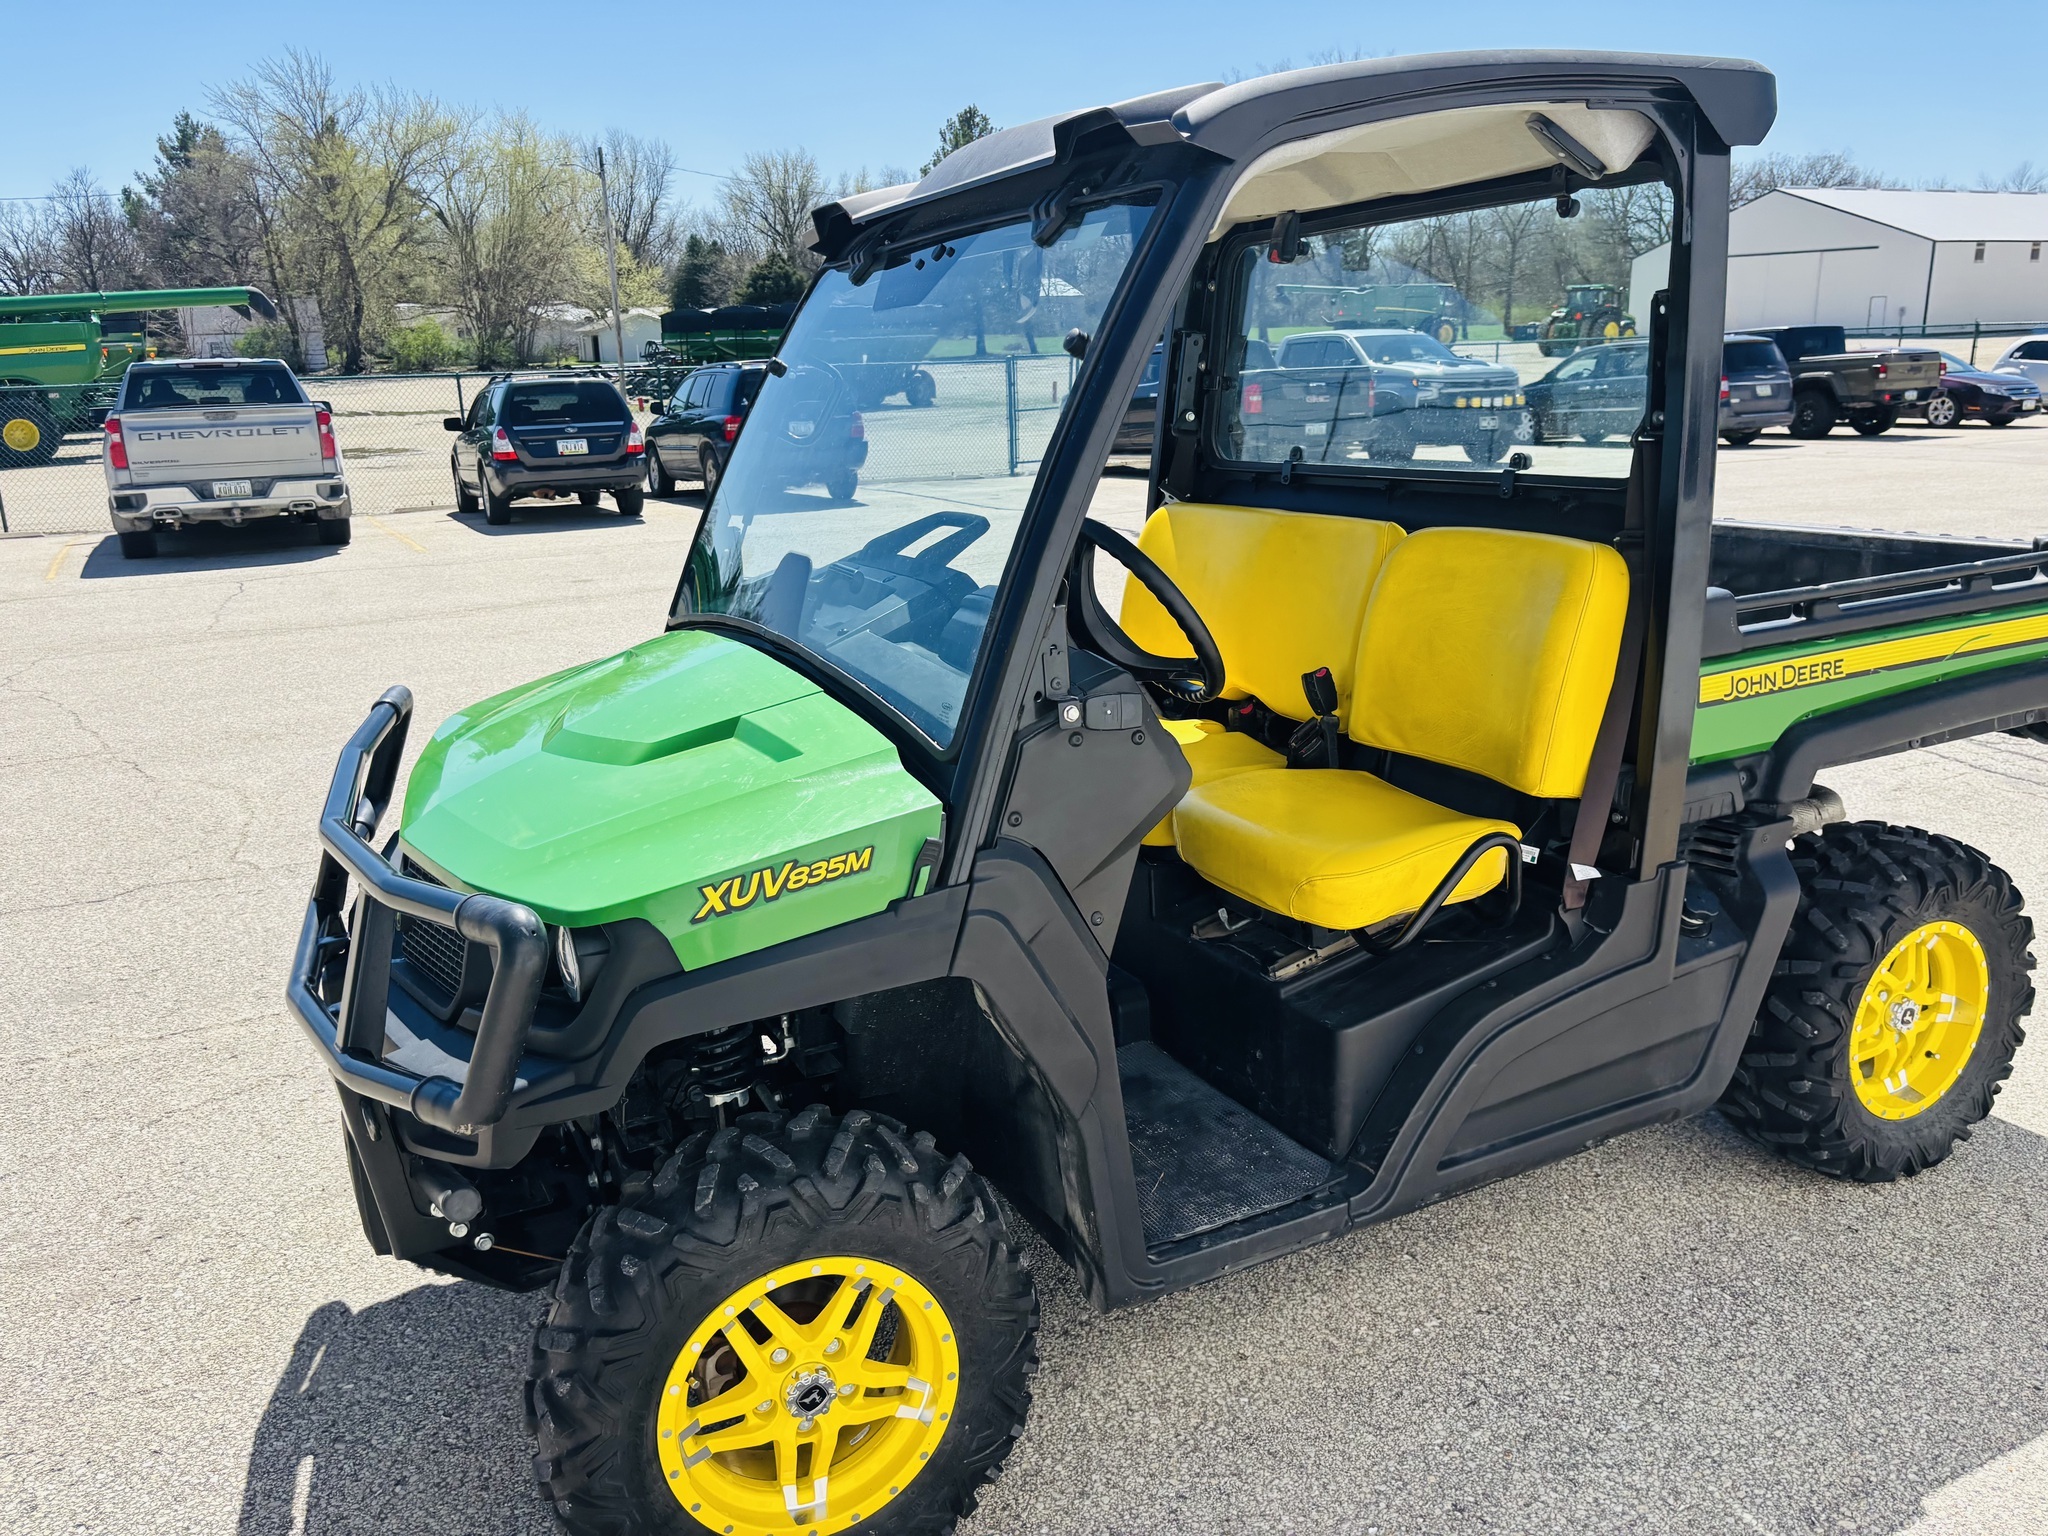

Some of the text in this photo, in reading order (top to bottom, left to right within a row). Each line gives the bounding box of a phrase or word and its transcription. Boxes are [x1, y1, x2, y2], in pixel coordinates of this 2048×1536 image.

[138, 427, 304, 441] CHEVROLET
[1724, 659, 1844, 698] JOHN DEERE
[691, 846, 874, 922] XUV835M
